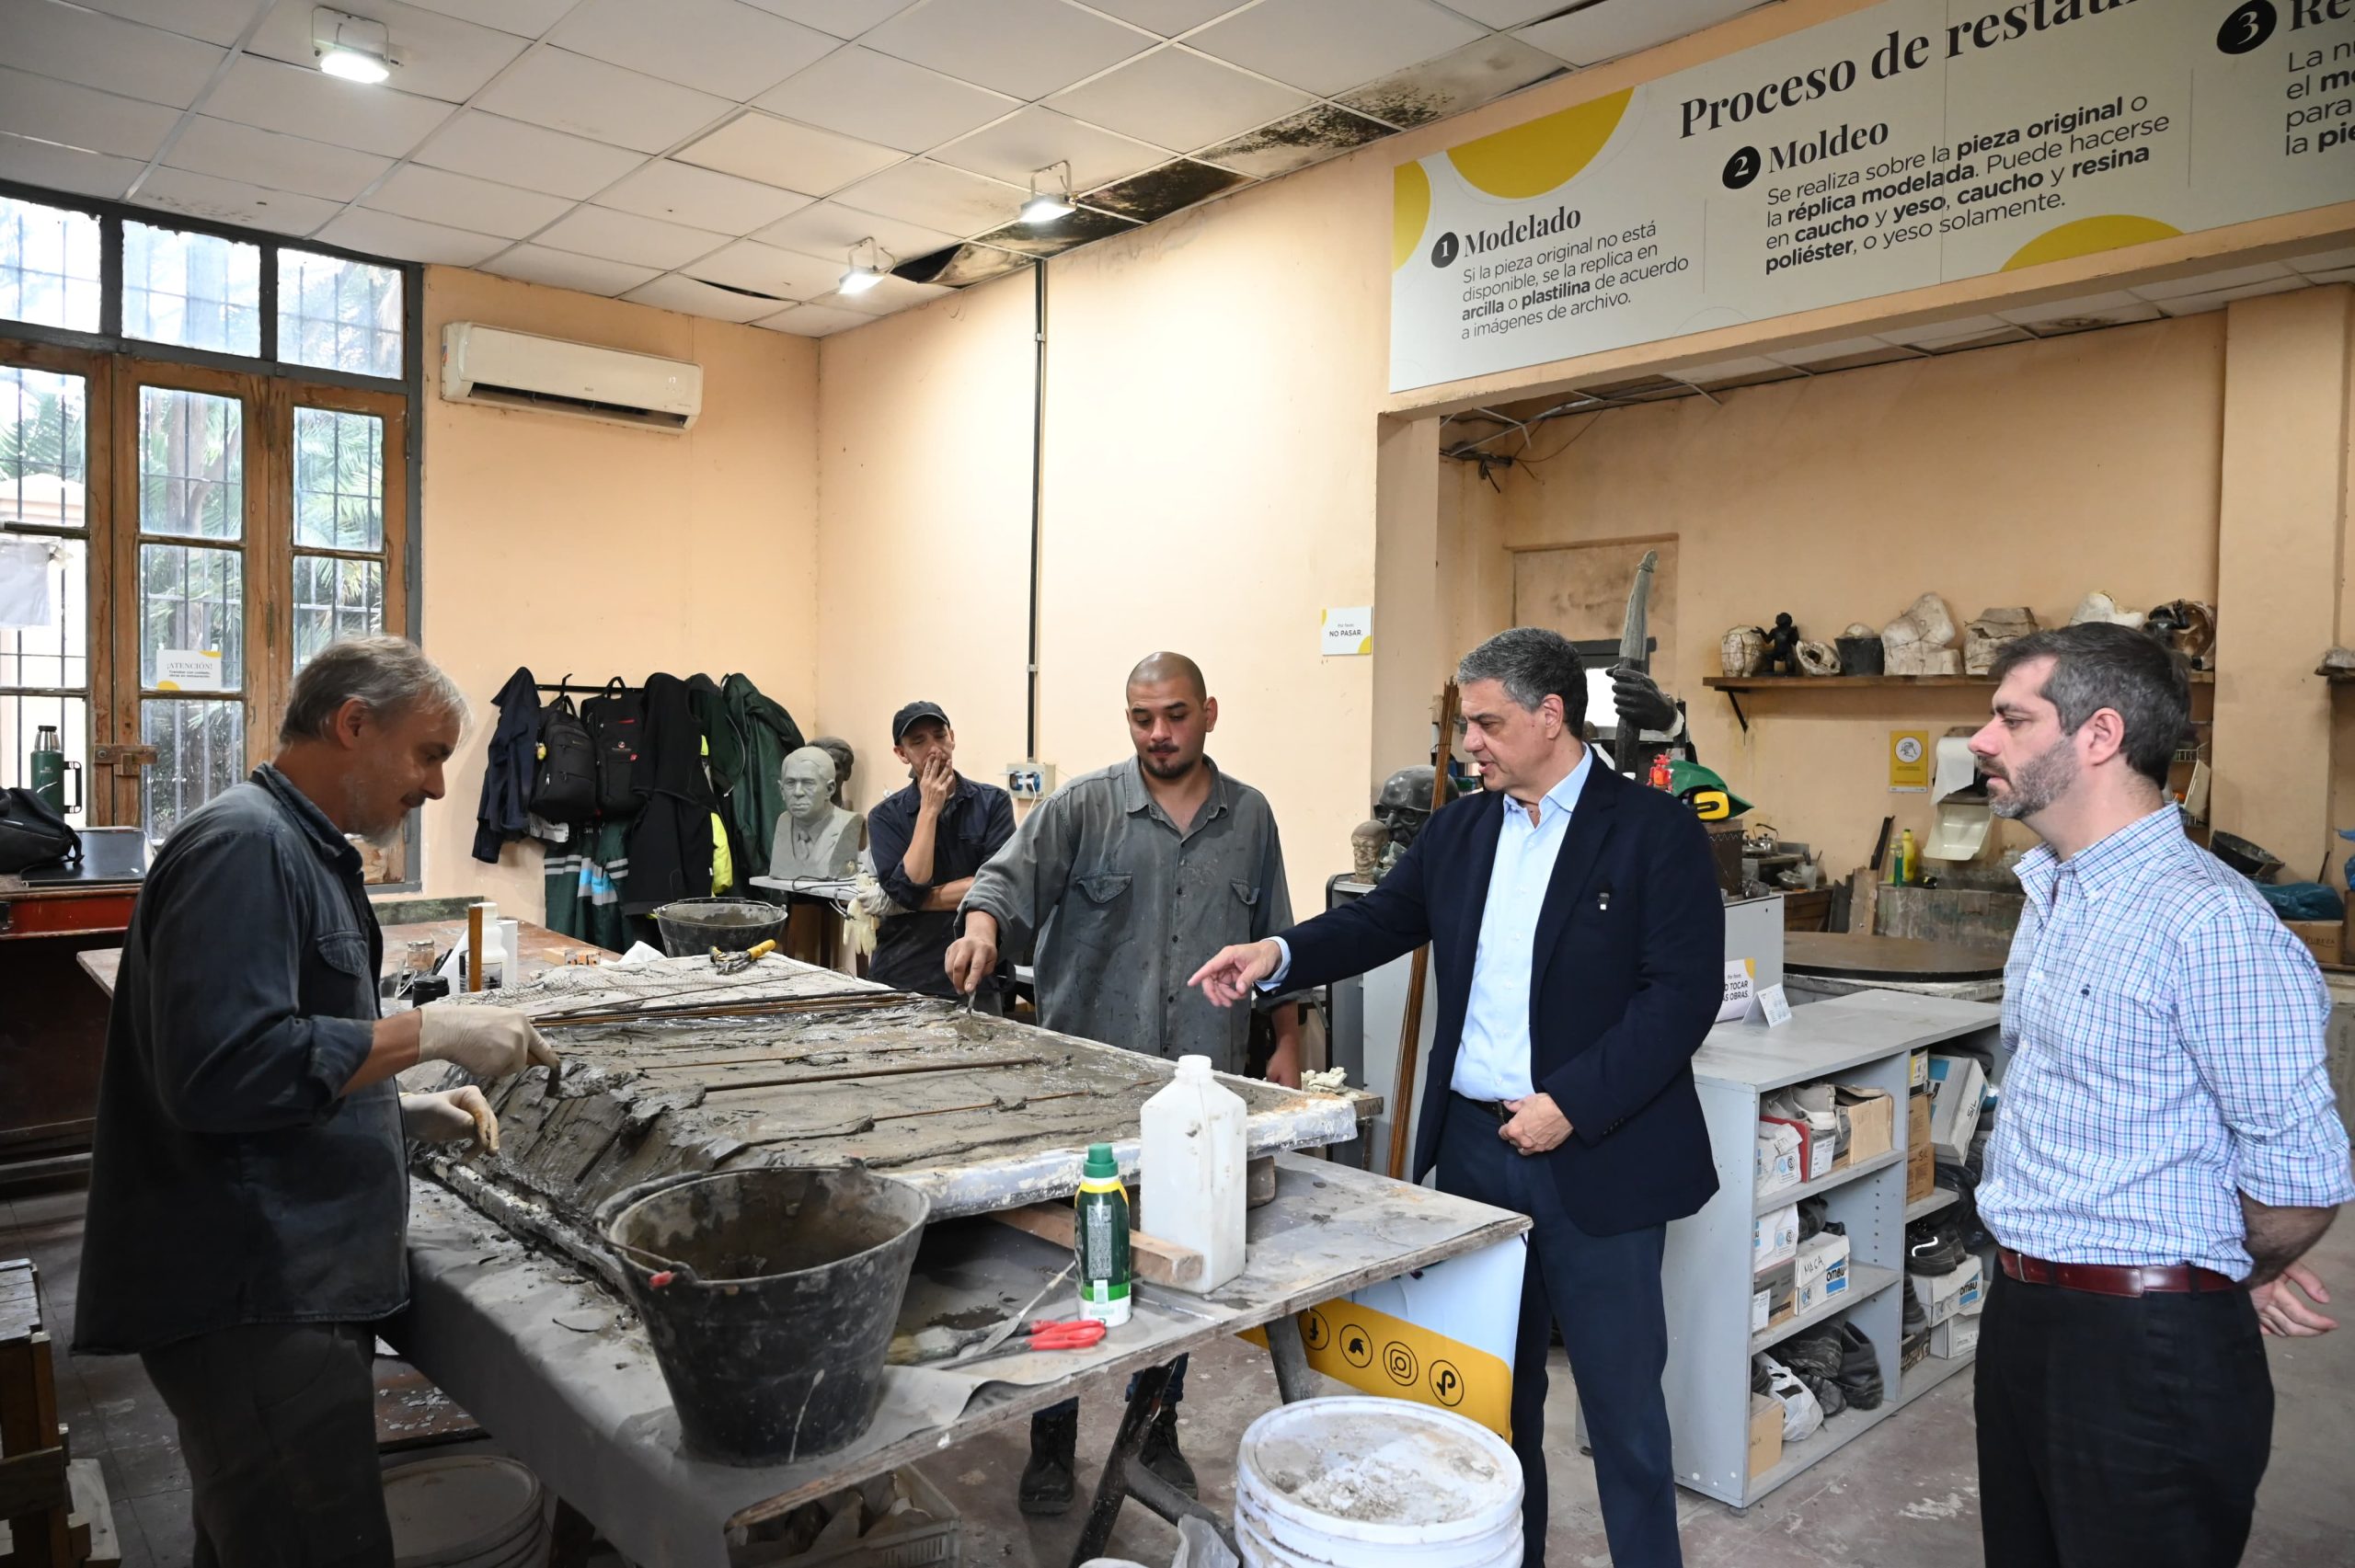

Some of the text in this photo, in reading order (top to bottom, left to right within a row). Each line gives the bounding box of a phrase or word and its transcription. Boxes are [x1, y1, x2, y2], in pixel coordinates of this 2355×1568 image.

[2236, 11, 2259, 45] 3
[2288, 0, 2355, 31] Re
[1679, 0, 2140, 139] Proceso de resta
[2286, 74, 2310, 99] el
[2289, 50, 2323, 73] La
[2286, 98, 2352, 133] para
[1734, 155, 1749, 177] 2
[1767, 95, 2148, 205] Se realiza sobre la pieza original o
[1768, 122, 1889, 174] Moldeo
[2285, 134, 2308, 156] la
[1766, 115, 2170, 228] la réplica modelada. Puede hacerse
[1766, 143, 2151, 249] en caucho y yeso, caucho y resina
[1464, 205, 1582, 258] Modelado
[1464, 220, 1657, 283] Si la pieza original no está
[1765, 192, 2066, 275] poliéster, o yeso solamente.
[1462, 255, 1689, 320] arcilla o plastilina de acuerdo
[1463, 243, 1658, 303] disponible, se la replica en
[1461, 291, 1631, 339] a imágenes de archivo.
[167, 662, 213, 670] ¡ATENCIÓN!
[1729, 980, 1748, 990] TOCAR
